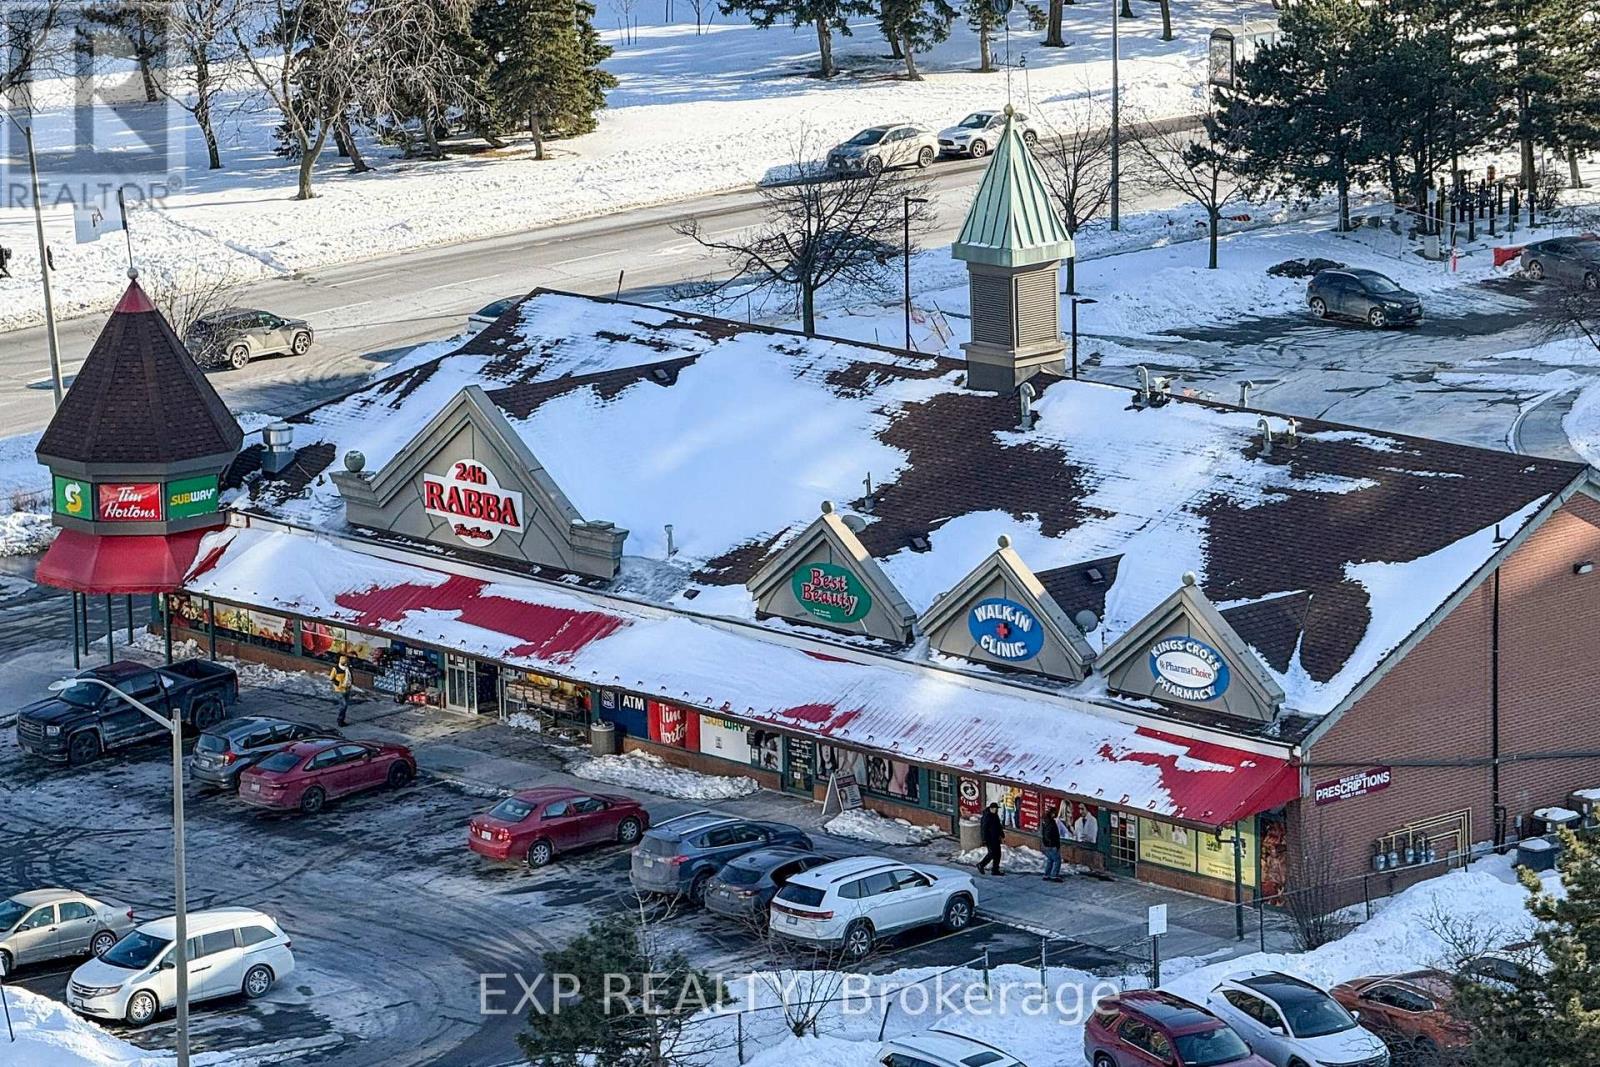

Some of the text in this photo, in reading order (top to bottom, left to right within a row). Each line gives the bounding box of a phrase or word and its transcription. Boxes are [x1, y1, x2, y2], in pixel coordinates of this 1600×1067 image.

[455, 463, 487, 485] 24h
[117, 487, 142, 502] Tim
[170, 488, 216, 506] SUBWAY
[424, 481, 520, 527] RABBA
[105, 501, 156, 518] Hortons
[811, 568, 848, 591] Best
[802, 583, 858, 616] Beauty
[974, 604, 1032, 632] WALK-IN
[981, 634, 1028, 657] CLINIC
[1151, 640, 1221, 671] KINGS CROSS
[1156, 676, 1216, 700] PHARMACY
[623, 695, 644, 711] ATM
[659, 703, 682, 723] Tim
[703, 717, 747, 733] SUBWAY
[1316, 771, 1390, 801] PRESCRIPTIONS
